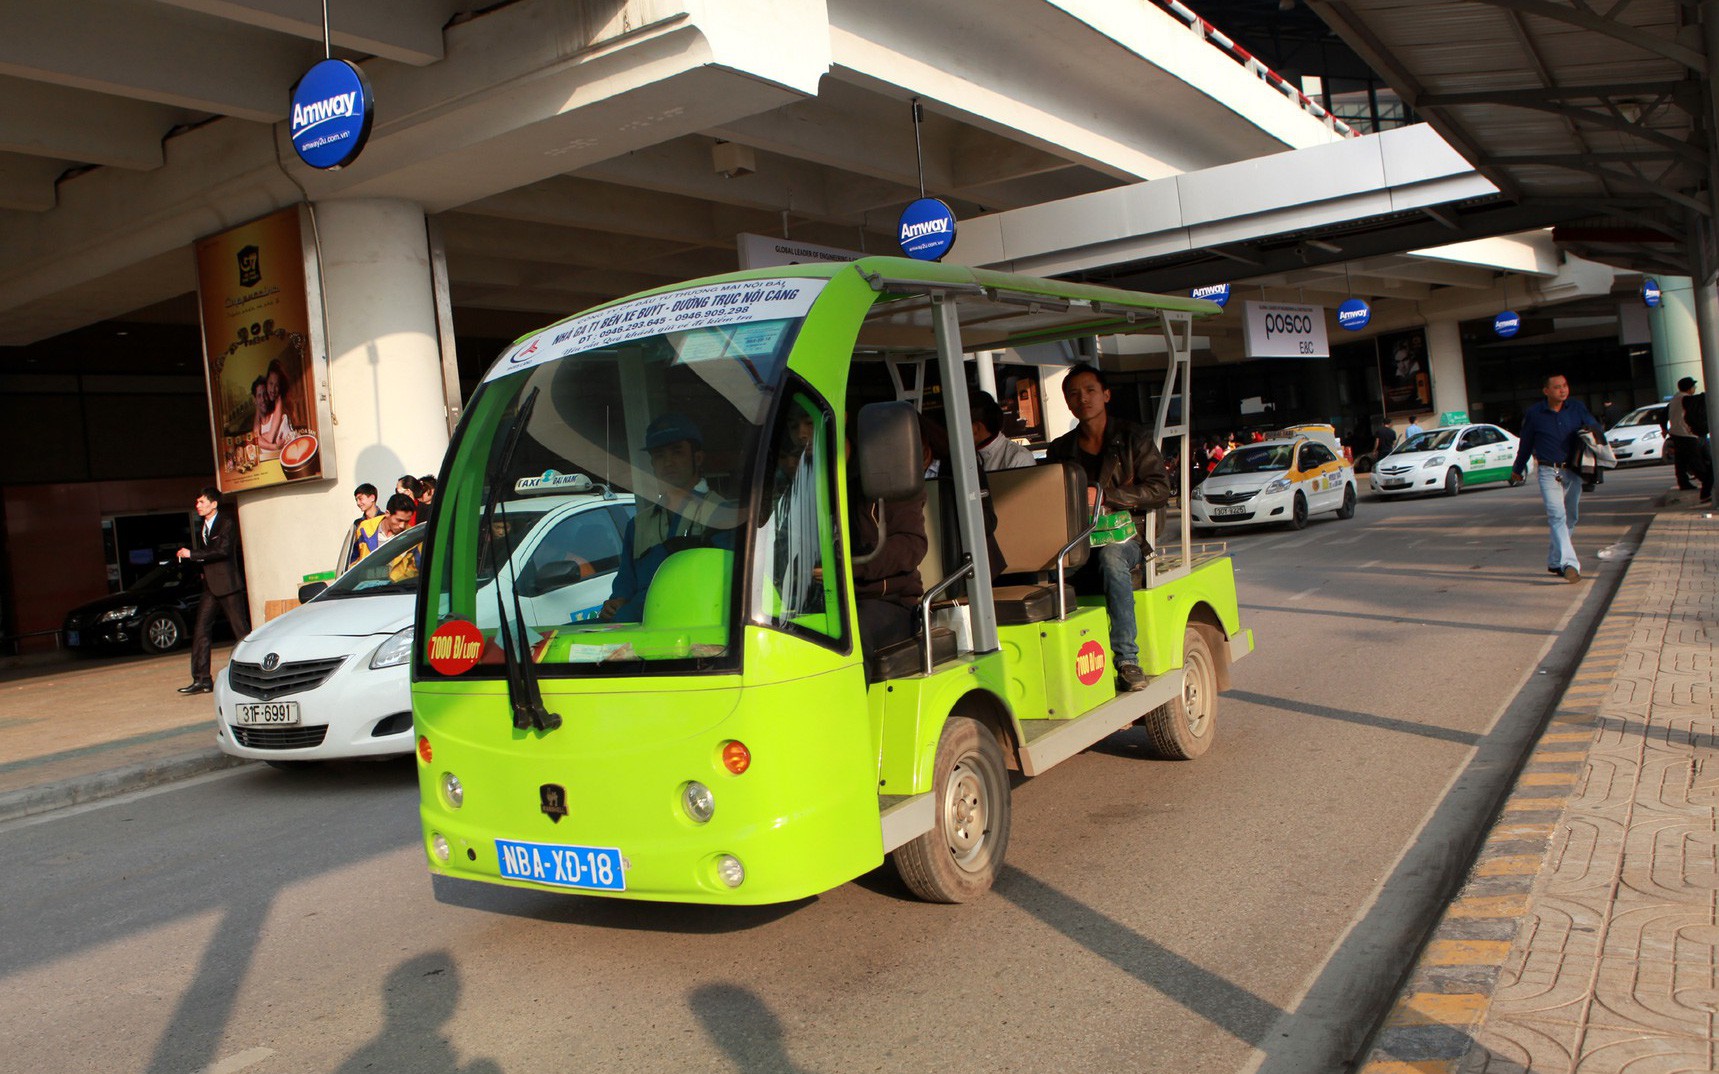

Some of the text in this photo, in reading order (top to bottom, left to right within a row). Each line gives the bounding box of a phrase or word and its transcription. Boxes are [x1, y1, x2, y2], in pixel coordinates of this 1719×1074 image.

[293, 91, 357, 130] Amway
[901, 217, 949, 239] Amway
[775, 245, 794, 255] GLOBAL
[795, 248, 812, 257] LEADER
[720, 284, 742, 292] MẠI
[1192, 284, 1226, 298] Amway
[622, 309, 638, 322] XE
[711, 291, 742, 308] TRỤC
[1339, 308, 1368, 320] Amway
[599, 317, 666, 338] 0946.293.645
[674, 306, 750, 322] 0946.909.298
[1265, 313, 1312, 340] posco
[1300, 341, 1314, 354] E&C
[517, 478, 541, 488] TAXI
[562, 474, 579, 484] NAM
[430, 635, 453, 660] 7000
[1076, 654, 1090, 677] 7000
